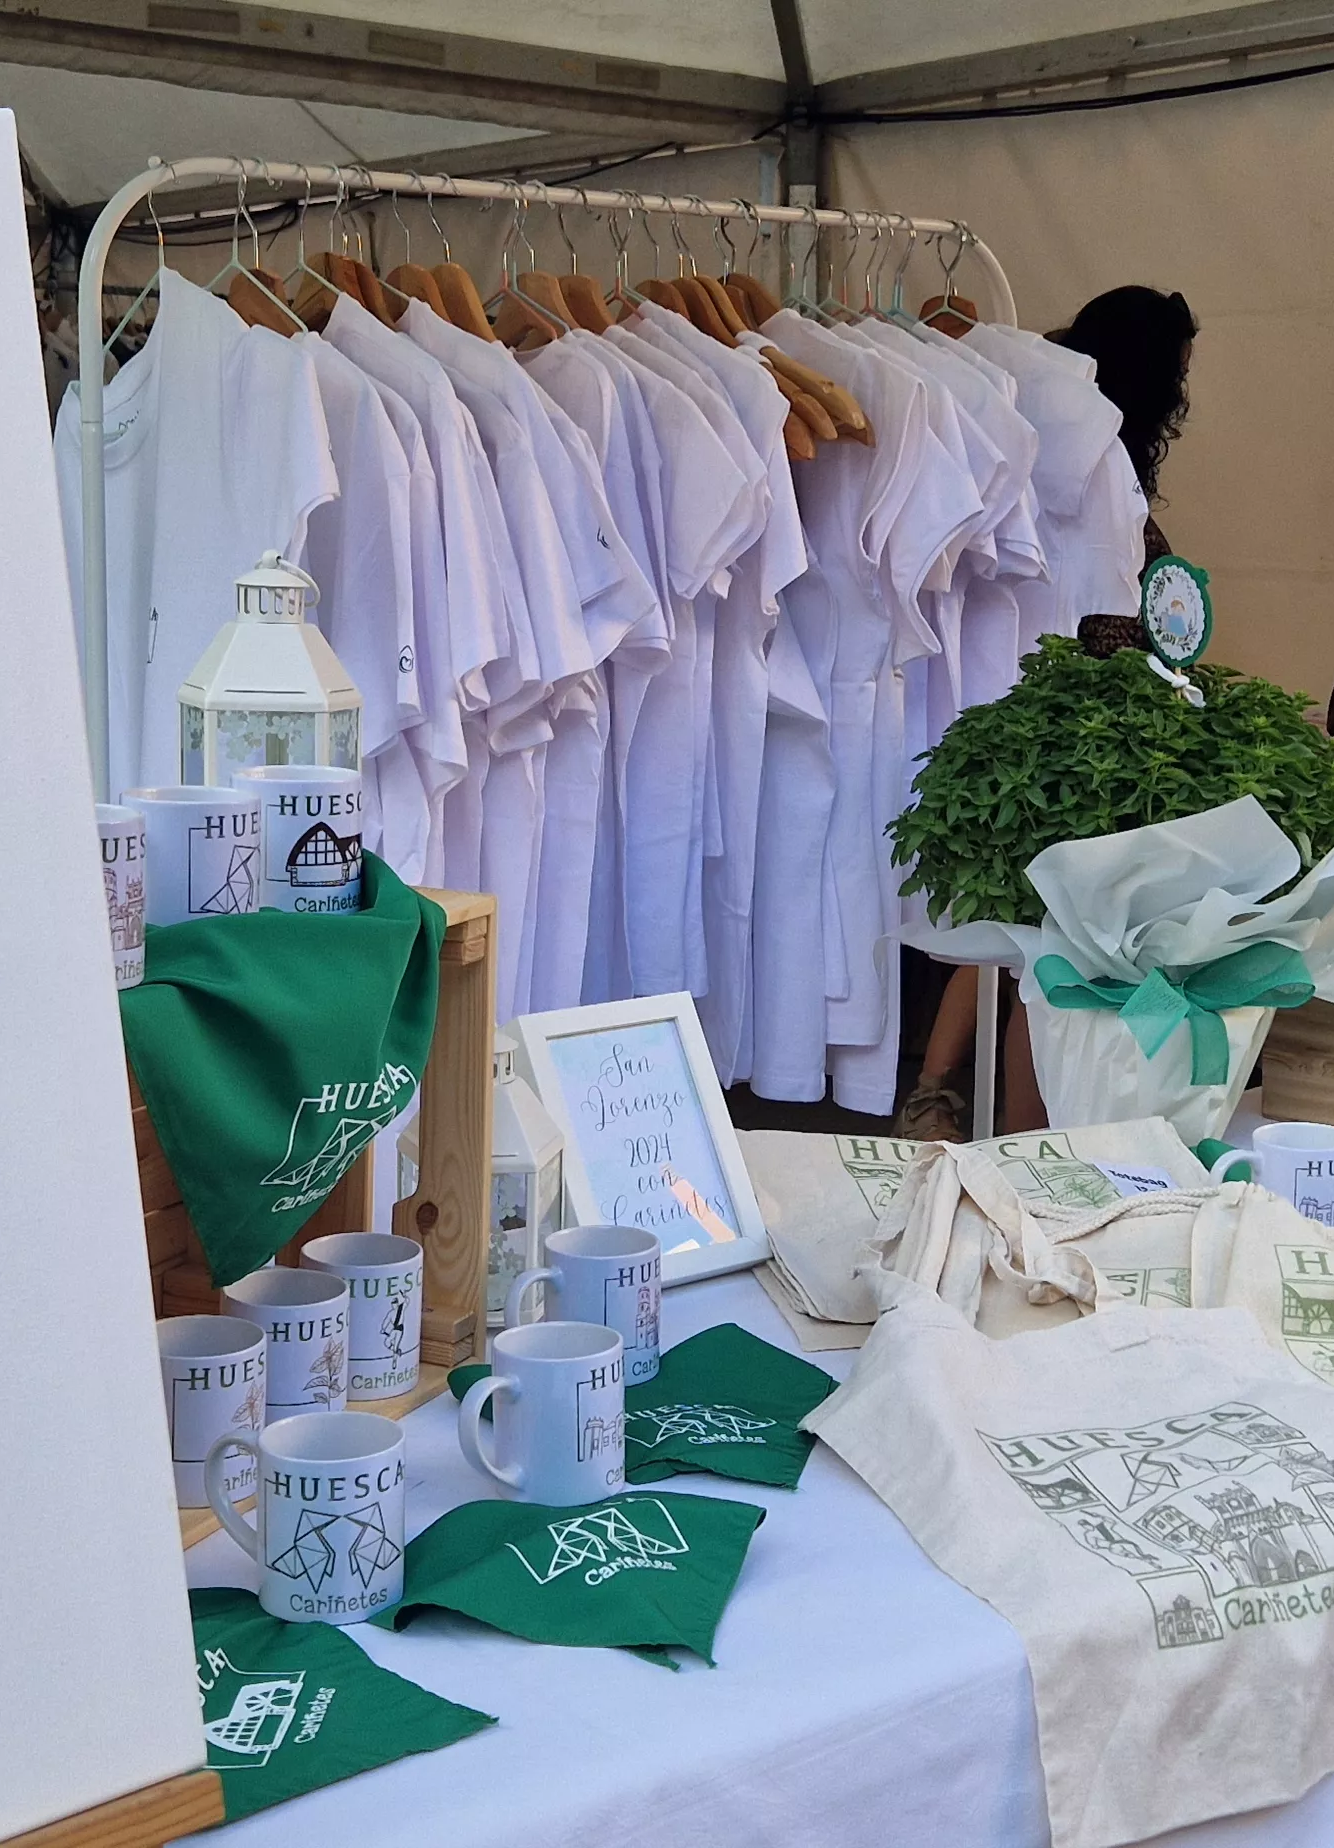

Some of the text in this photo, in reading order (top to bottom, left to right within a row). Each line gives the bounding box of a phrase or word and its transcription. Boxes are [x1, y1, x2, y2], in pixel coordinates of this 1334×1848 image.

[597, 1043, 654, 1088] San
[580, 1085, 687, 1132] Lorenzo
[624, 1132, 672, 1168] 2024
[637, 1169, 680, 1195] con
[991, 1411, 1254, 1468] HUESCA
[272, 1459, 405, 1502] HUESCA
[289, 1587, 388, 1615] Cariñetes
